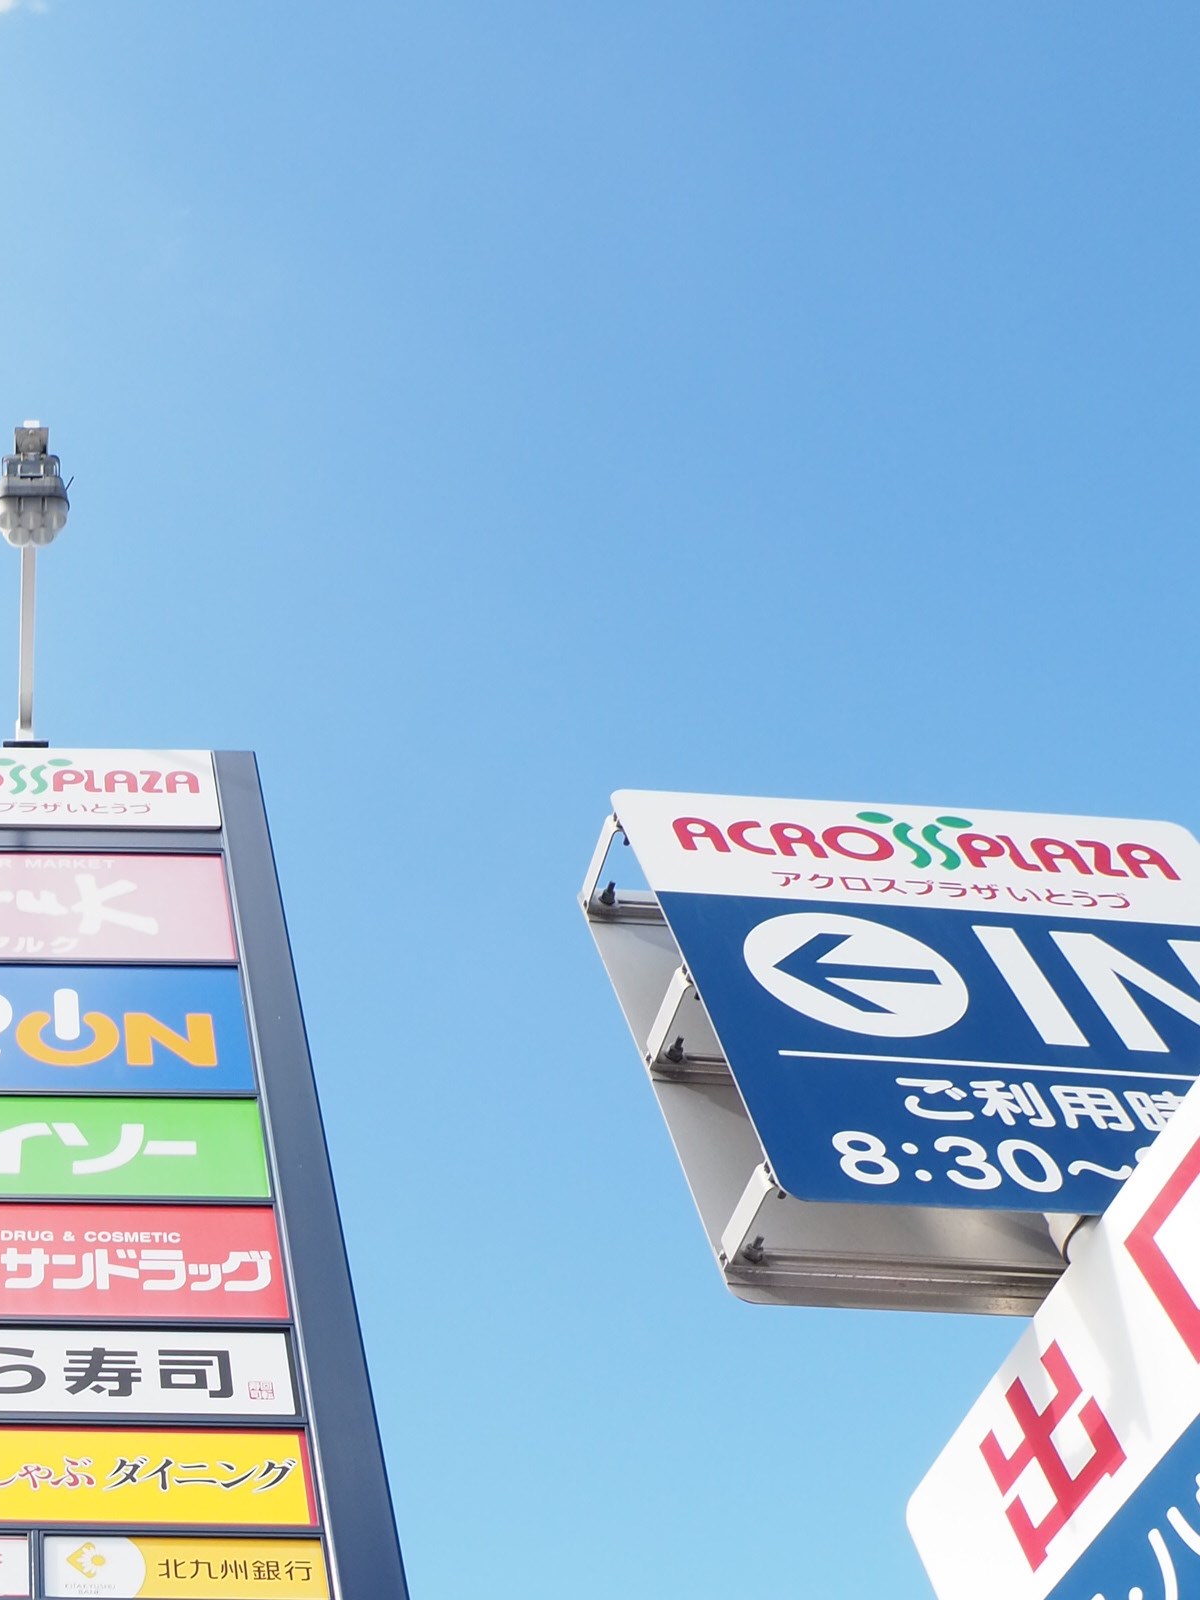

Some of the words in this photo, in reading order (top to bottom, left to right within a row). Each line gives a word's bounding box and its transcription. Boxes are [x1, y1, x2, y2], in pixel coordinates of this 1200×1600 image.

[25, 857, 115, 870] MARKET
[0, 1230, 54, 1242] DRUG
[63, 1231, 75, 1242] &
[84, 1231, 181, 1243] COSMETIC
[0, 1248, 273, 1292] サンドラッグ
[157, 1559, 313, 1582] 北九州銀行
